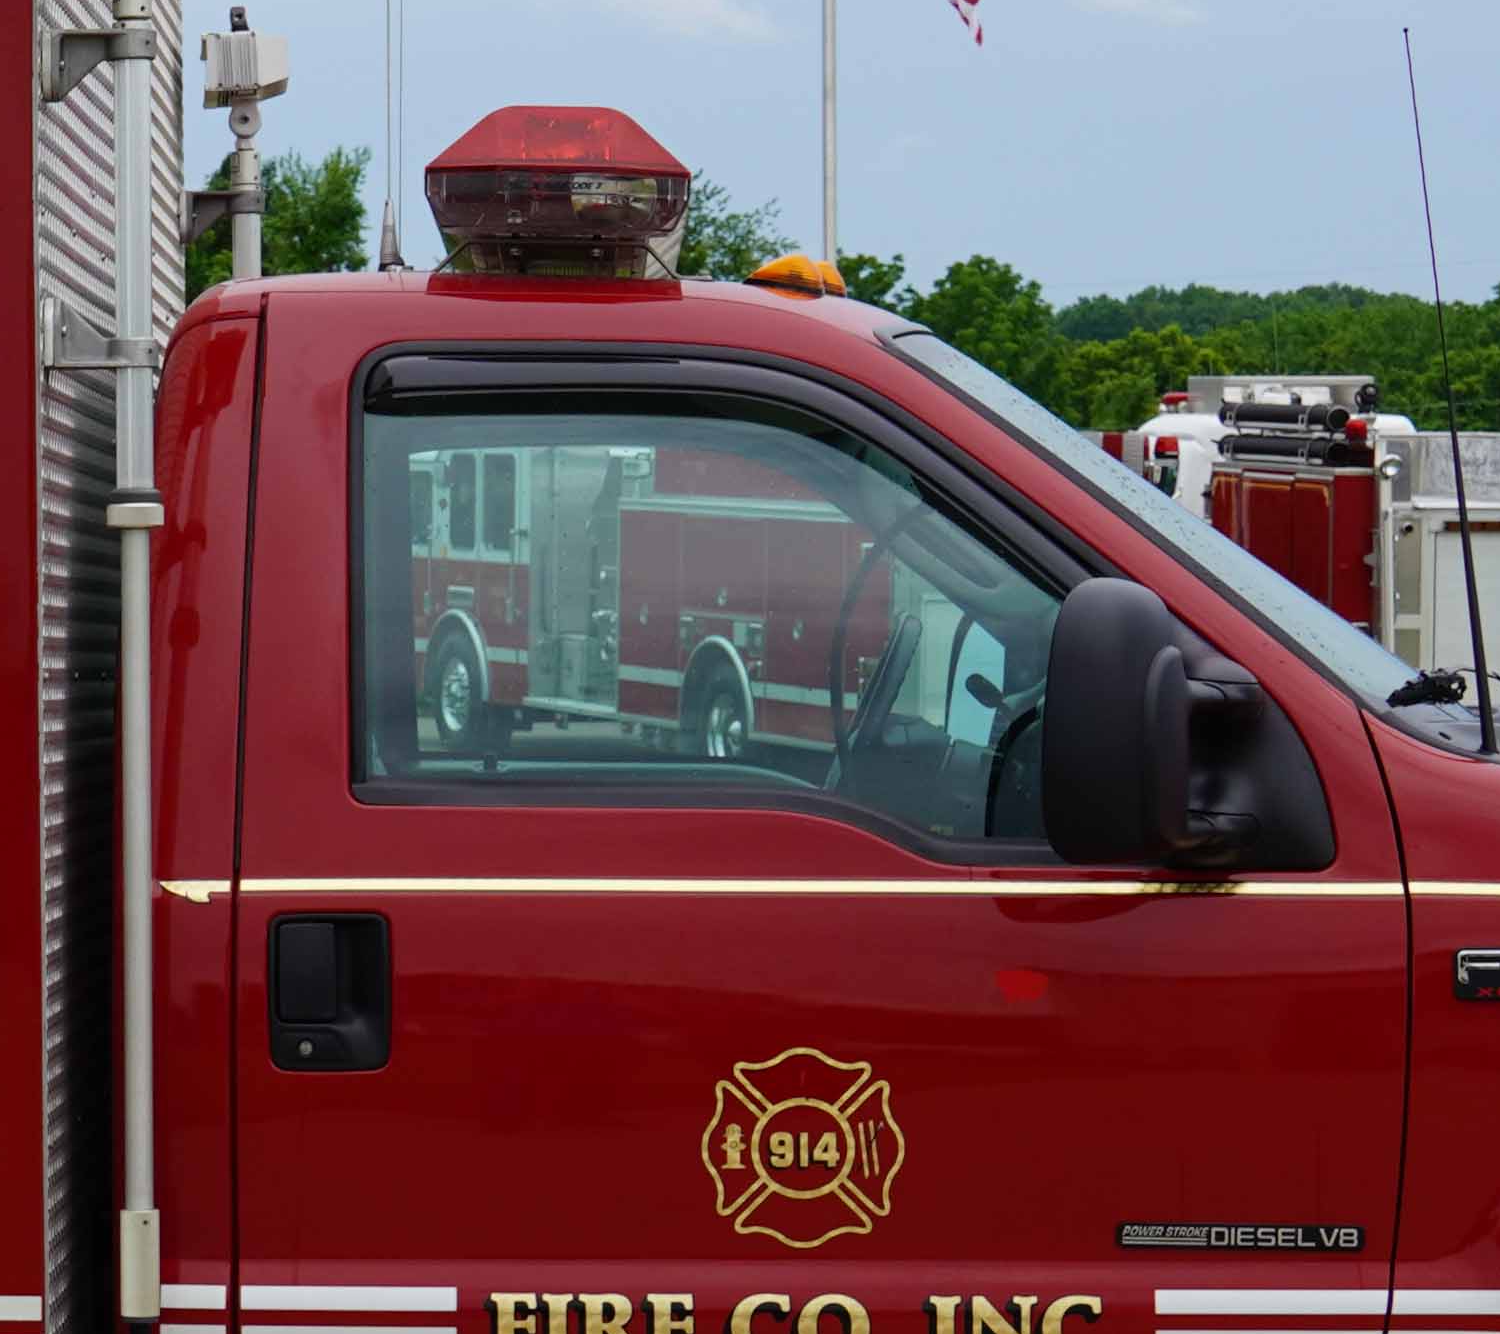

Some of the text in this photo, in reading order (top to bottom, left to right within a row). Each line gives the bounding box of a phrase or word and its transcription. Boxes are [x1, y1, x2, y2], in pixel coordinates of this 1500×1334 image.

[769, 1131, 841, 1168] 914
[1122, 1225, 1359, 1248] POWER STROKE DIESEL V8
